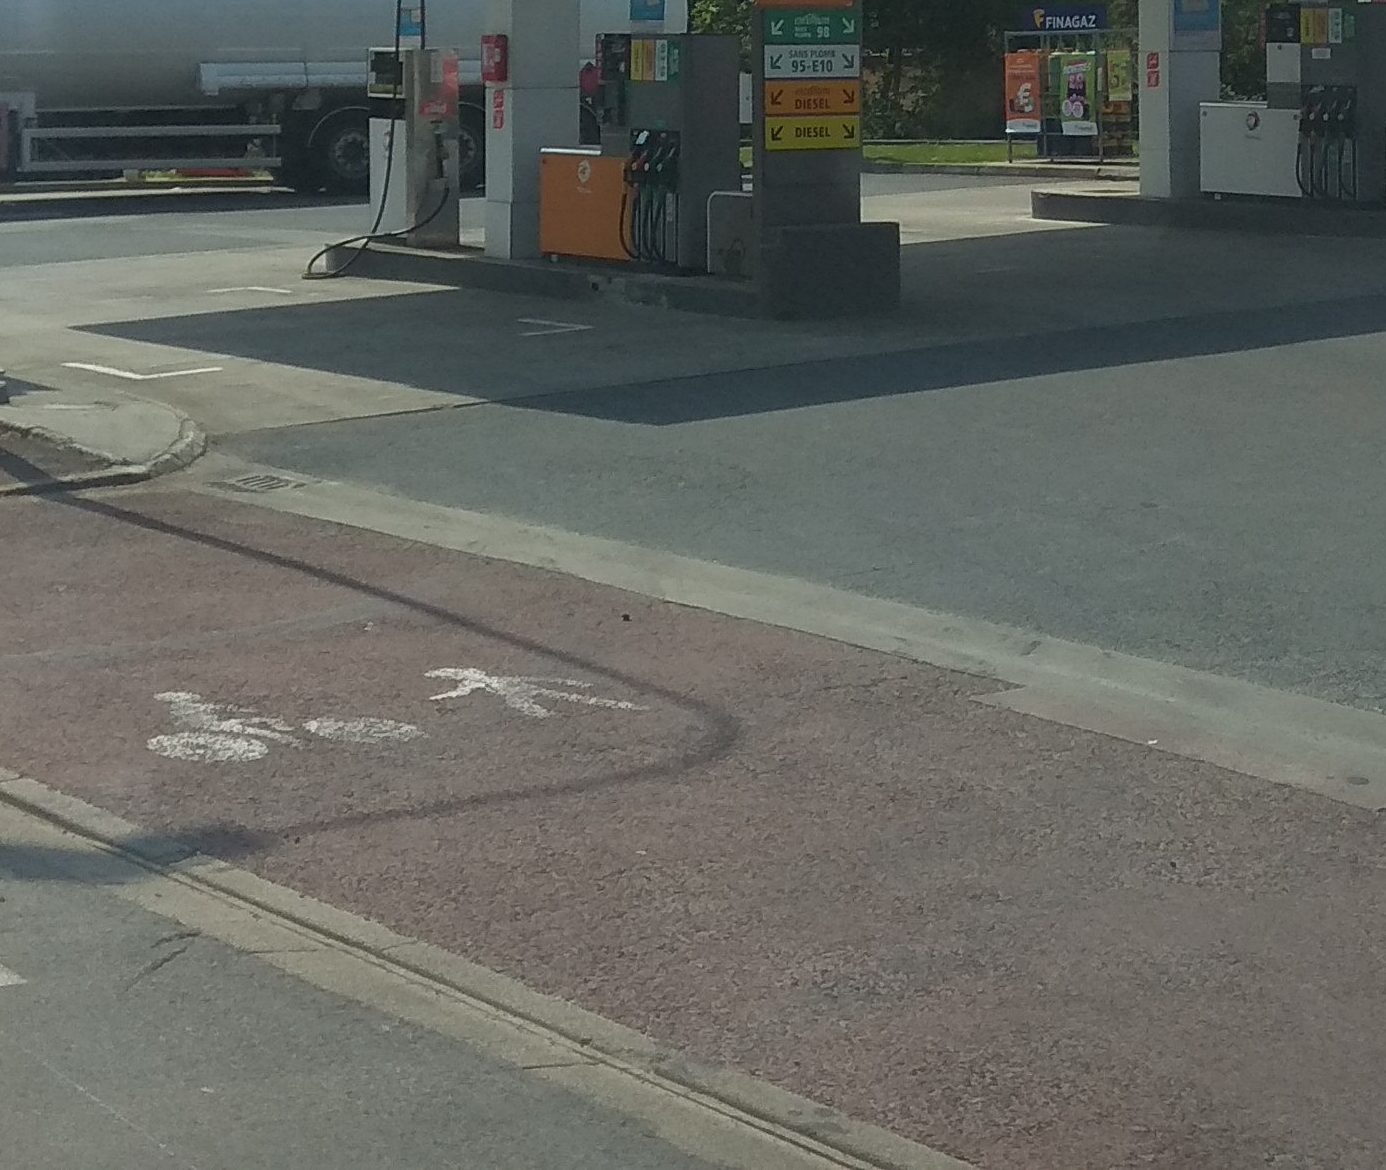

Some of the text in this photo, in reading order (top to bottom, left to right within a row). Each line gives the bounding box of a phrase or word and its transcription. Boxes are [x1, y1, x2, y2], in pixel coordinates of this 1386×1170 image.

[1045, 14, 1097, 30] FINAGAZ
[816, 25, 831, 38] 98
[788, 49, 809, 59] SANS
[791, 59, 834, 73] 95-E10
[794, 98, 831, 110] DIESEL
[794, 126, 831, 138] DIESEL
